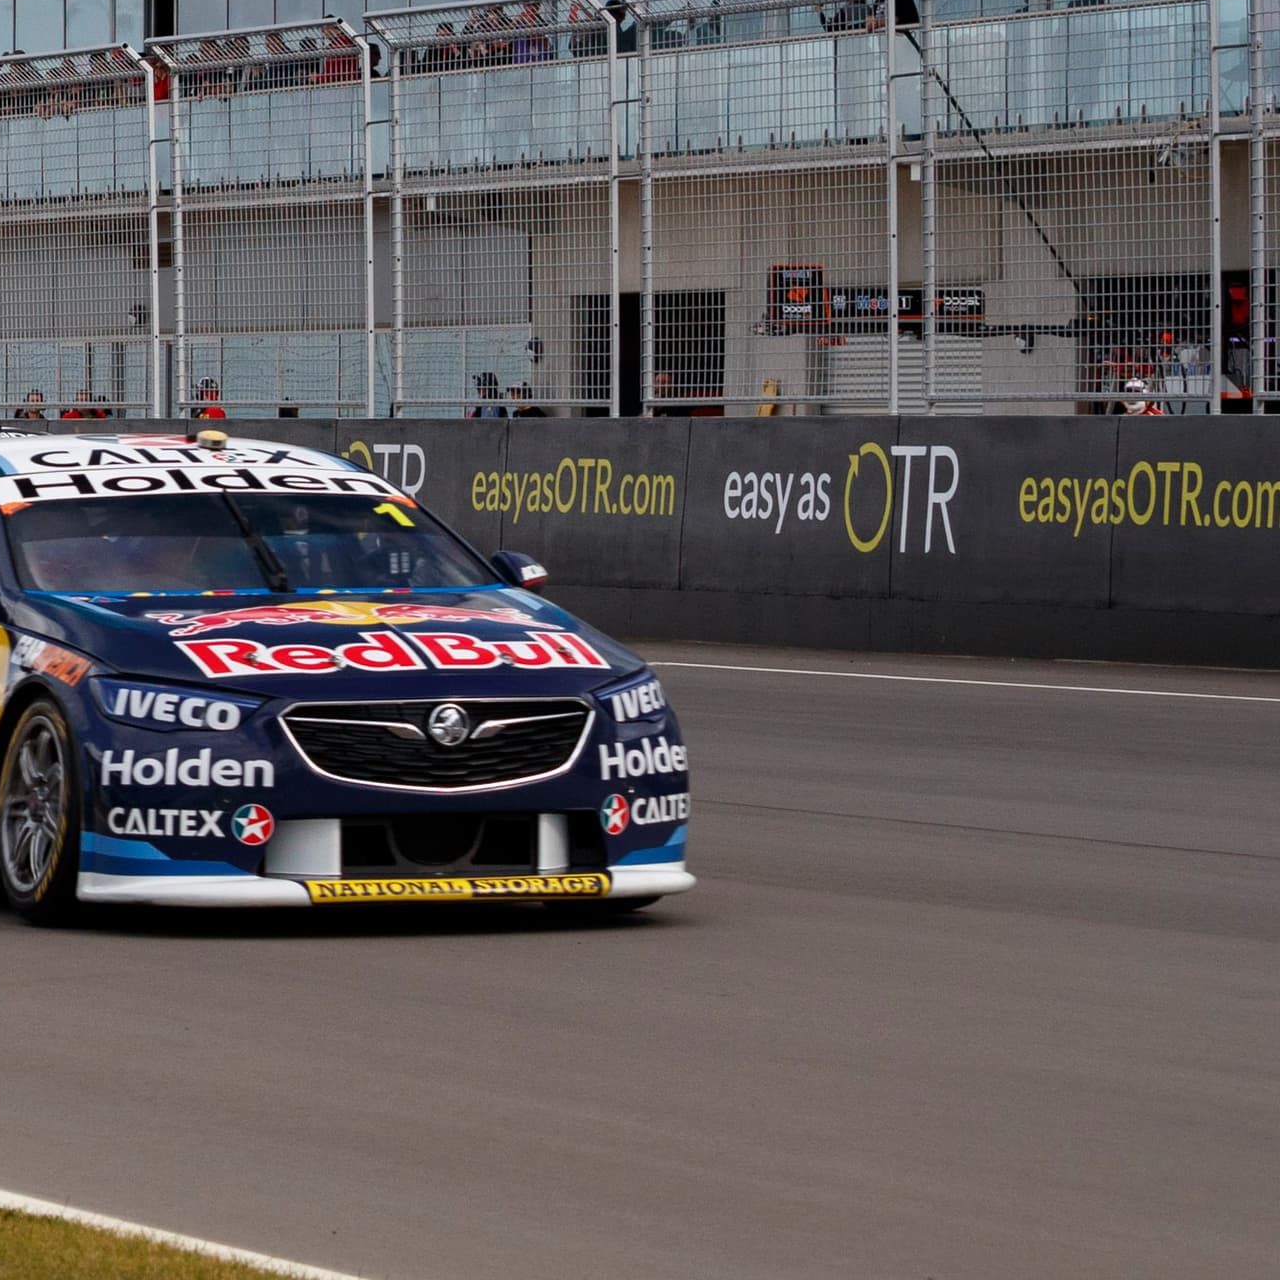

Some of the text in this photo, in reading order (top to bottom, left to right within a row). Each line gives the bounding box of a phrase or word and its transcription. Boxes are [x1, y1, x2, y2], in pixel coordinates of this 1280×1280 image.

[13, 468, 393, 500] Holden
[471, 457, 675, 524] easyasOTR.com
[723, 442, 960, 554] easy as OTR
[1018, 460, 1280, 537] easyasOTR.com
[373, 502, 416, 527] 1
[174, 630, 611, 678] Red Bull
[113, 688, 241, 731] IVECO
[101, 748, 275, 788] Holden
[599, 736, 688, 781] Holde
[108, 807, 225, 838] CALTEX
[631, 792, 690, 825] CALTE
[316, 874, 601, 898] NATIONAL STORAGE
